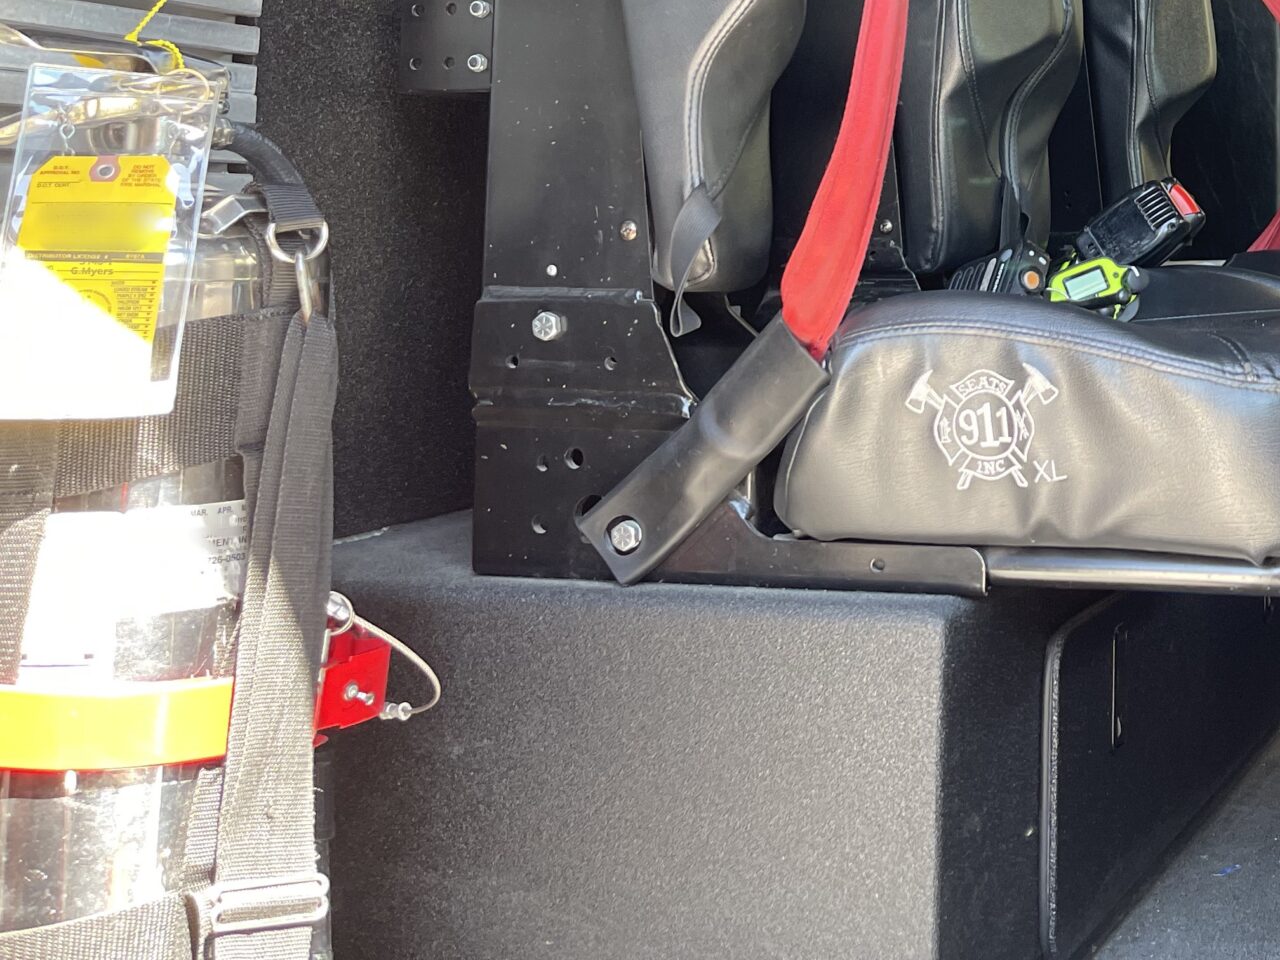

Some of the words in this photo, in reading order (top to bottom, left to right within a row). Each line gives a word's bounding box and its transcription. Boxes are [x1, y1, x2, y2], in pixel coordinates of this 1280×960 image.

[70, 266, 114, 276] G.Myers
[959, 377, 1008, 396] SEATS
[958, 402, 1012, 447] 911
[977, 460, 1006, 476] INC
[1033, 459, 1068, 484] XL
[217, 506, 233, 514] APR.
